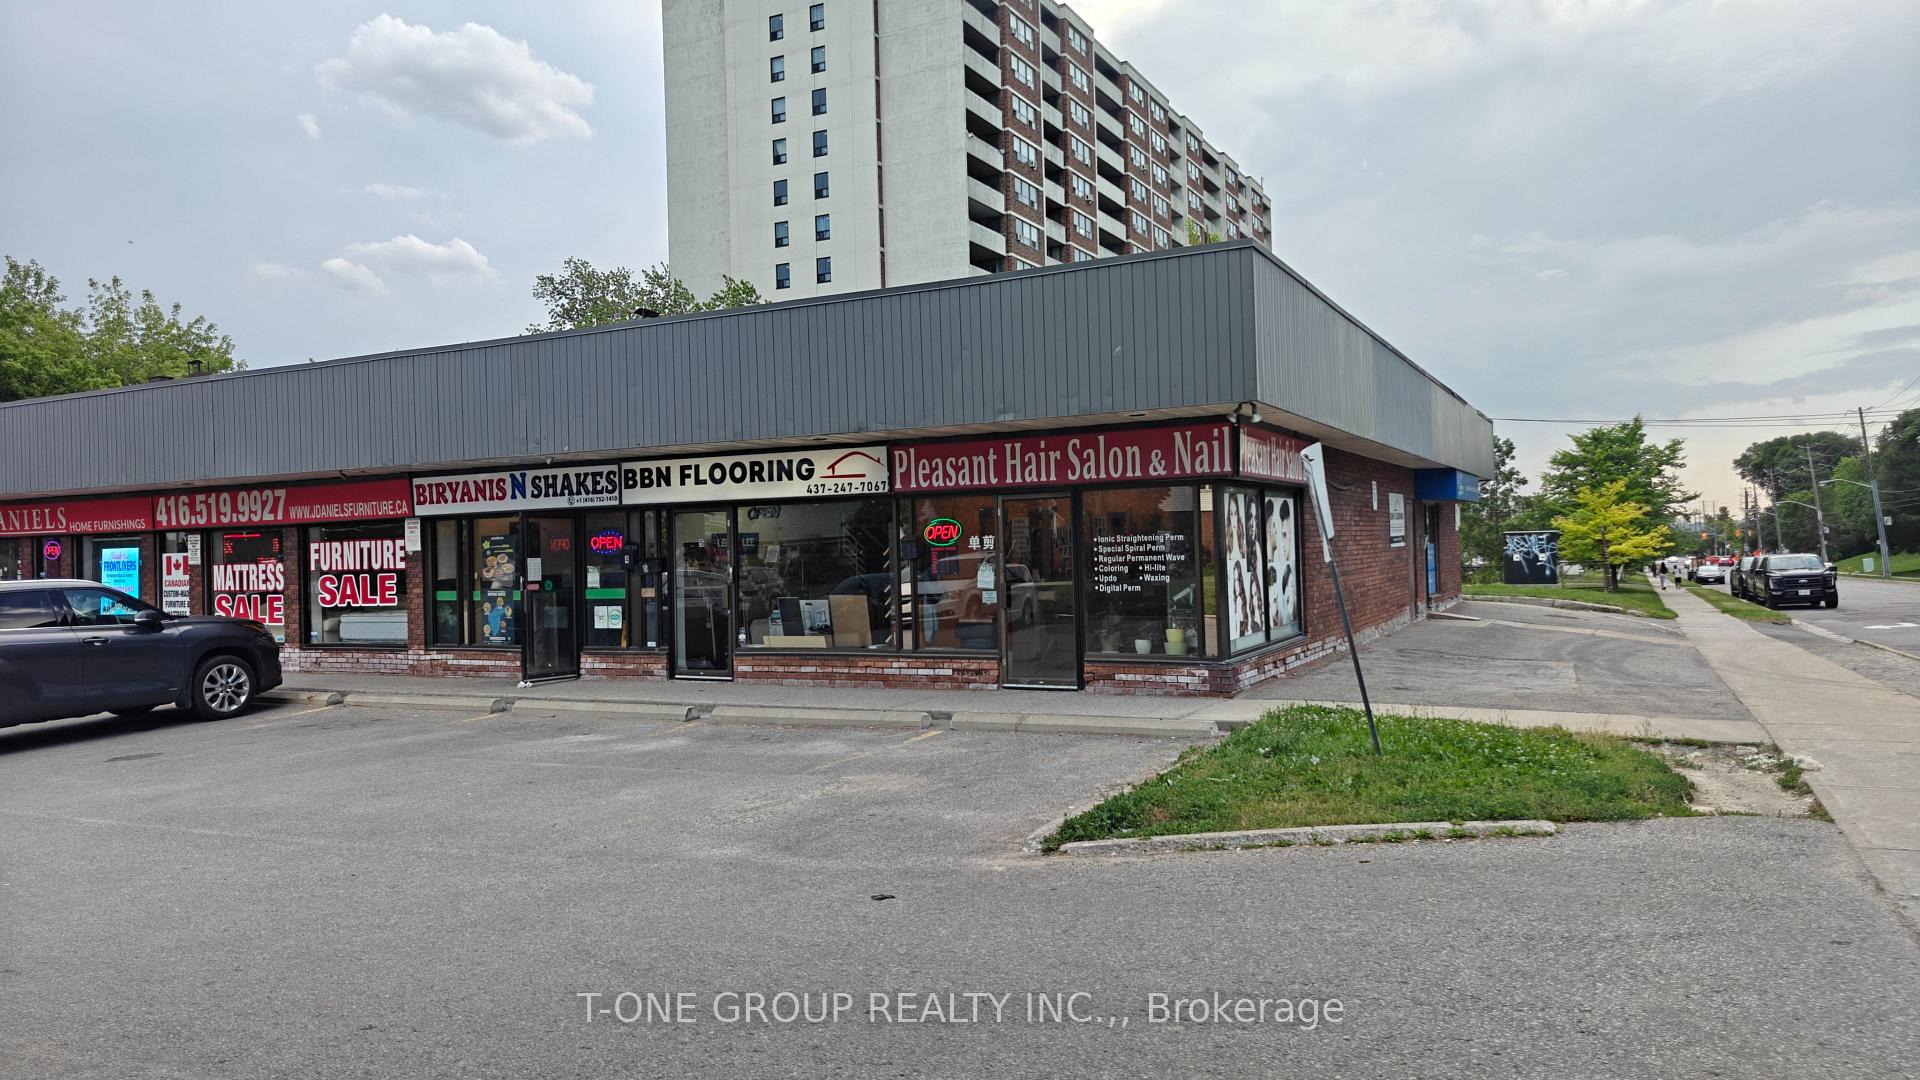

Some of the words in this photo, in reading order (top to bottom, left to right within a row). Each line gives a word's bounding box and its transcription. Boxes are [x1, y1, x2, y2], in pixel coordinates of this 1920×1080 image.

[894, 447, 998, 489] Pleasant
[1004, 440, 1061, 484] Hair
[1067, 435, 1142, 481] Salon
[1149, 449, 1167, 476] &
[1173, 426, 1232, 475] Nail
[1239, 427, 1271, 476] Pleasant
[1271, 436, 1286, 478] Hair
[623, 465, 671, 489] BBN
[679, 457, 815, 487] FLOORING
[415, 478, 507, 506] BIRYANIS
[509, 472, 527, 500] N
[530, 470, 618, 498] SHAKES
[806, 480, 887, 495] 437-247-7067
[156, 489, 286, 526] 416.519.9927
[289, 500, 408, 519] WWW.JDANIELSFURNITURE.CA
[69, 520, 93, 532] HOME
[93, 518, 146, 531] FURNISHINGS
[925, 525, 958, 540] OPEN
[590, 535, 622, 549] OPEN
[717, 539, 727, 547] LE
[968, 535, 995, 550] 单剪
[1098, 535, 1115, 543] Ionic
[1116, 534, 1164, 544] Straightening
[1165, 533, 1184, 541] Perm
[310, 540, 406, 571] FURNITURE
[1098, 545, 1124, 554] Special
[1124, 545, 1146, 555] Spiral
[1147, 544, 1166, 552] Perm
[1098, 555, 1126, 564] Regular
[1126, 554, 1165, 562] Permanent
[1166, 553, 1185, 561] Wave
[213, 563, 284, 591] MATTRESS
[1098, 565, 1129, 574] Coloring
[1099, 575, 1118, 583] Updo
[1143, 574, 1170, 583] Waxing
[318, 573, 397, 608] SALE
[1099, 584, 1122, 593] Digital
[1123, 584, 1141, 592] Perm
[215, 594, 284, 625] SALE
